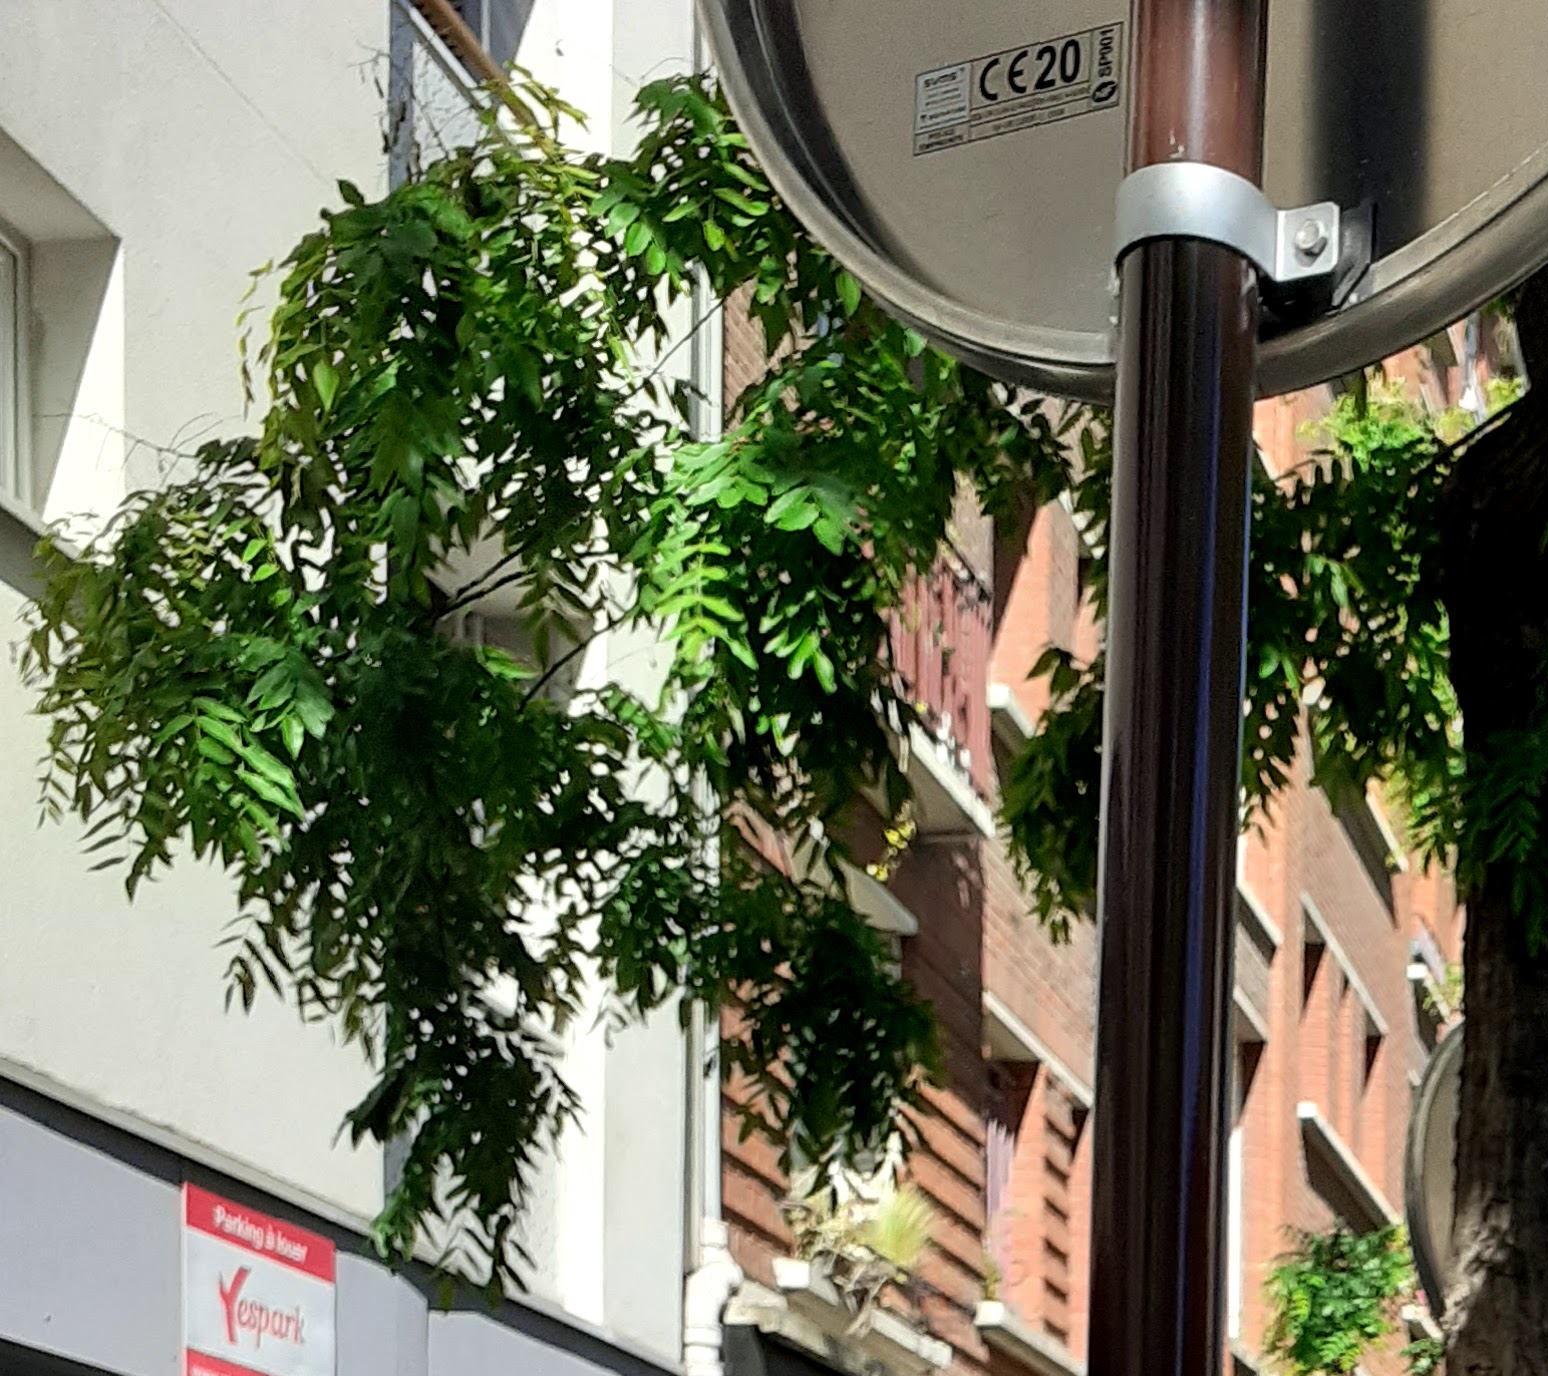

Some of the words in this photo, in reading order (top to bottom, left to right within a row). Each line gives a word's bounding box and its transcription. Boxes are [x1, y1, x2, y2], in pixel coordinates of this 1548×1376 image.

[213, 1204, 264, 1250] Parking
[264, 1224, 275, 1250] à
[276, 1229, 308, 1264] louer
[218, 1265, 305, 1350] Yespark
